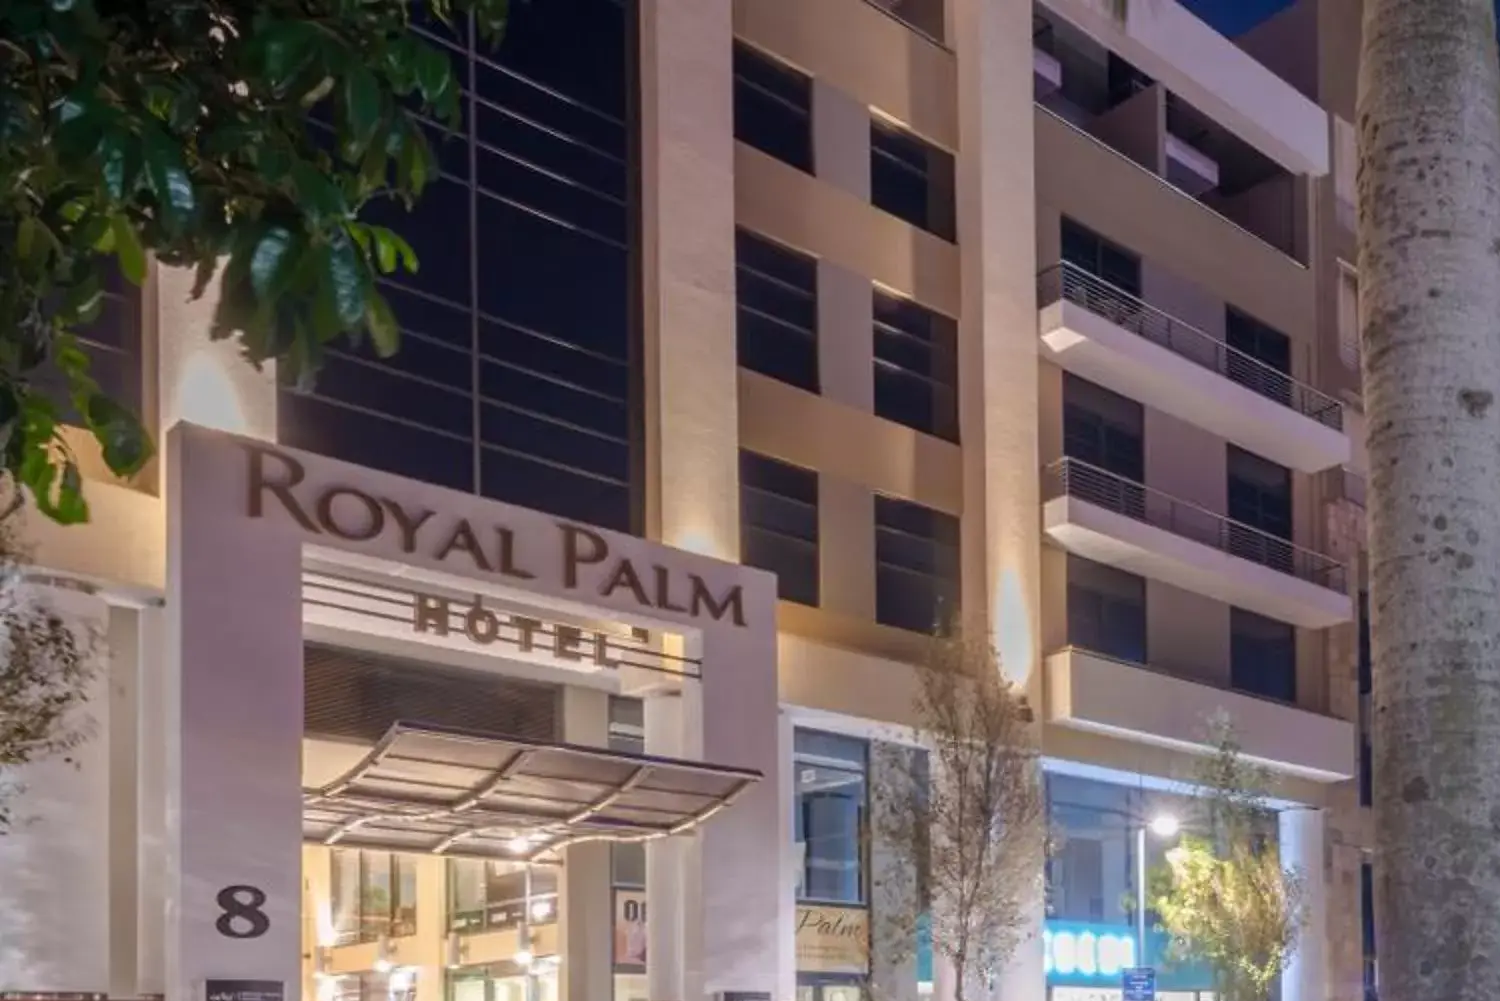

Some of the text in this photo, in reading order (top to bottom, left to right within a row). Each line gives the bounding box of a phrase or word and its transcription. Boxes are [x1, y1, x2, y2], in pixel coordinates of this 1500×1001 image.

[244, 442, 748, 627] ROYAL PALM
[413, 592, 619, 669] HOTEL
[215, 885, 270, 938] 8
